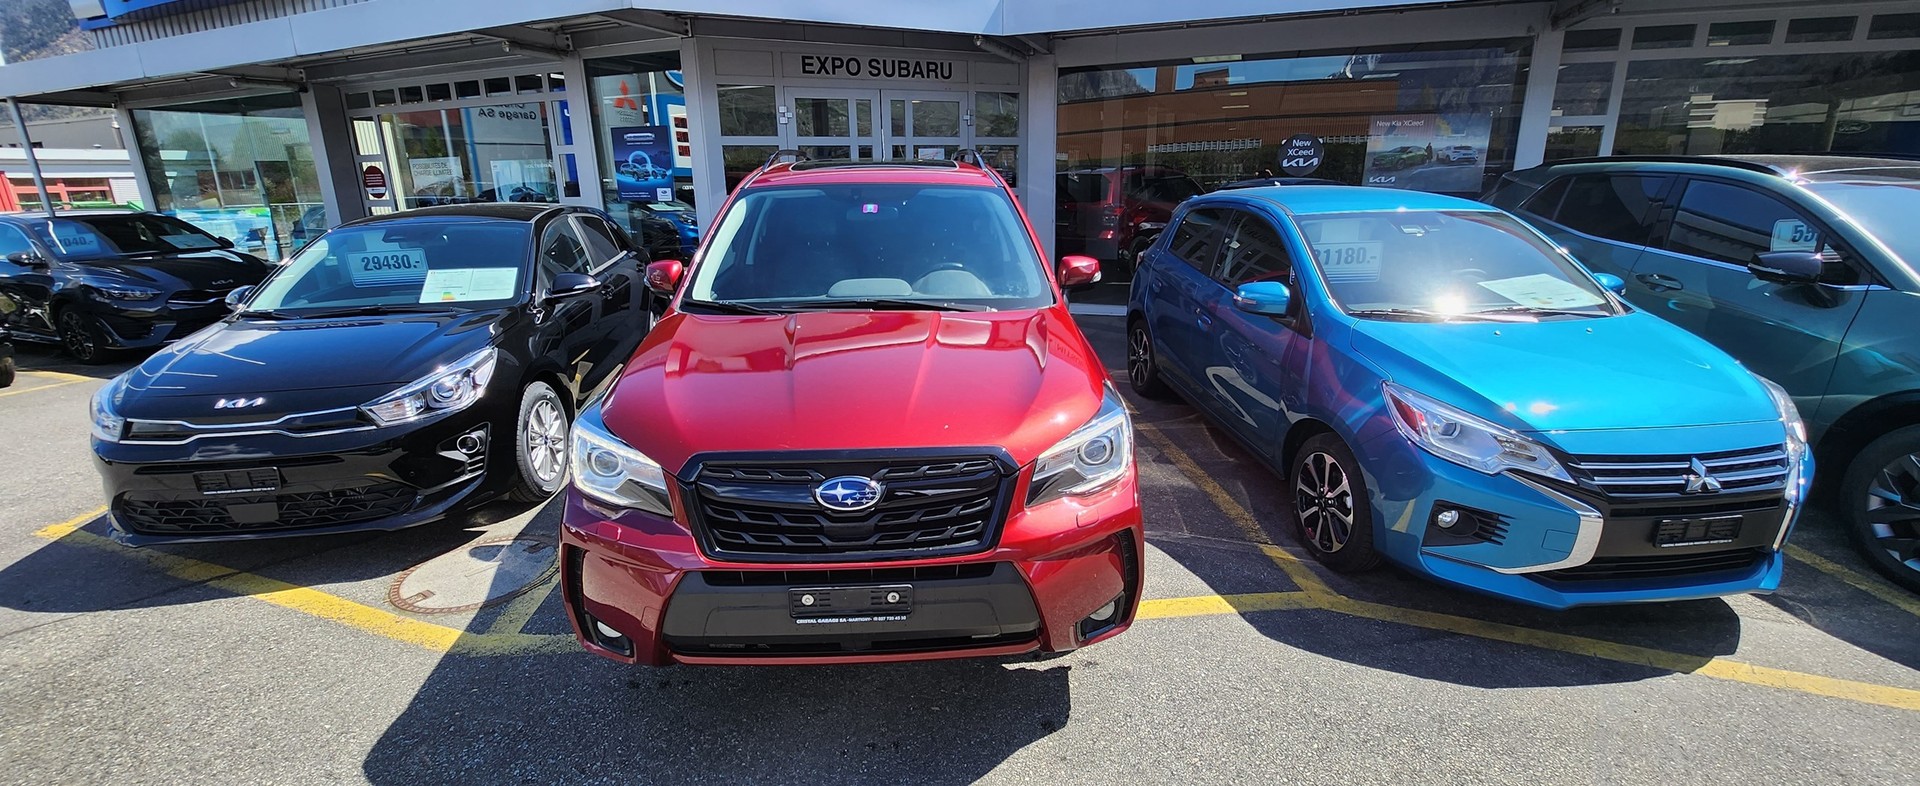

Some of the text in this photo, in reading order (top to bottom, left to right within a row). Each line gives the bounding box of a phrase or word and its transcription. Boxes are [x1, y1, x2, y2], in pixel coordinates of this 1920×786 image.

[801, 55, 953, 80] EXPO SUBARU
[1402, 119, 1425, 127] XCeed
[1292, 139, 1312, 147] New
[1287, 147, 1314, 156] XCeed
[361, 253, 421, 272] 29430.-
